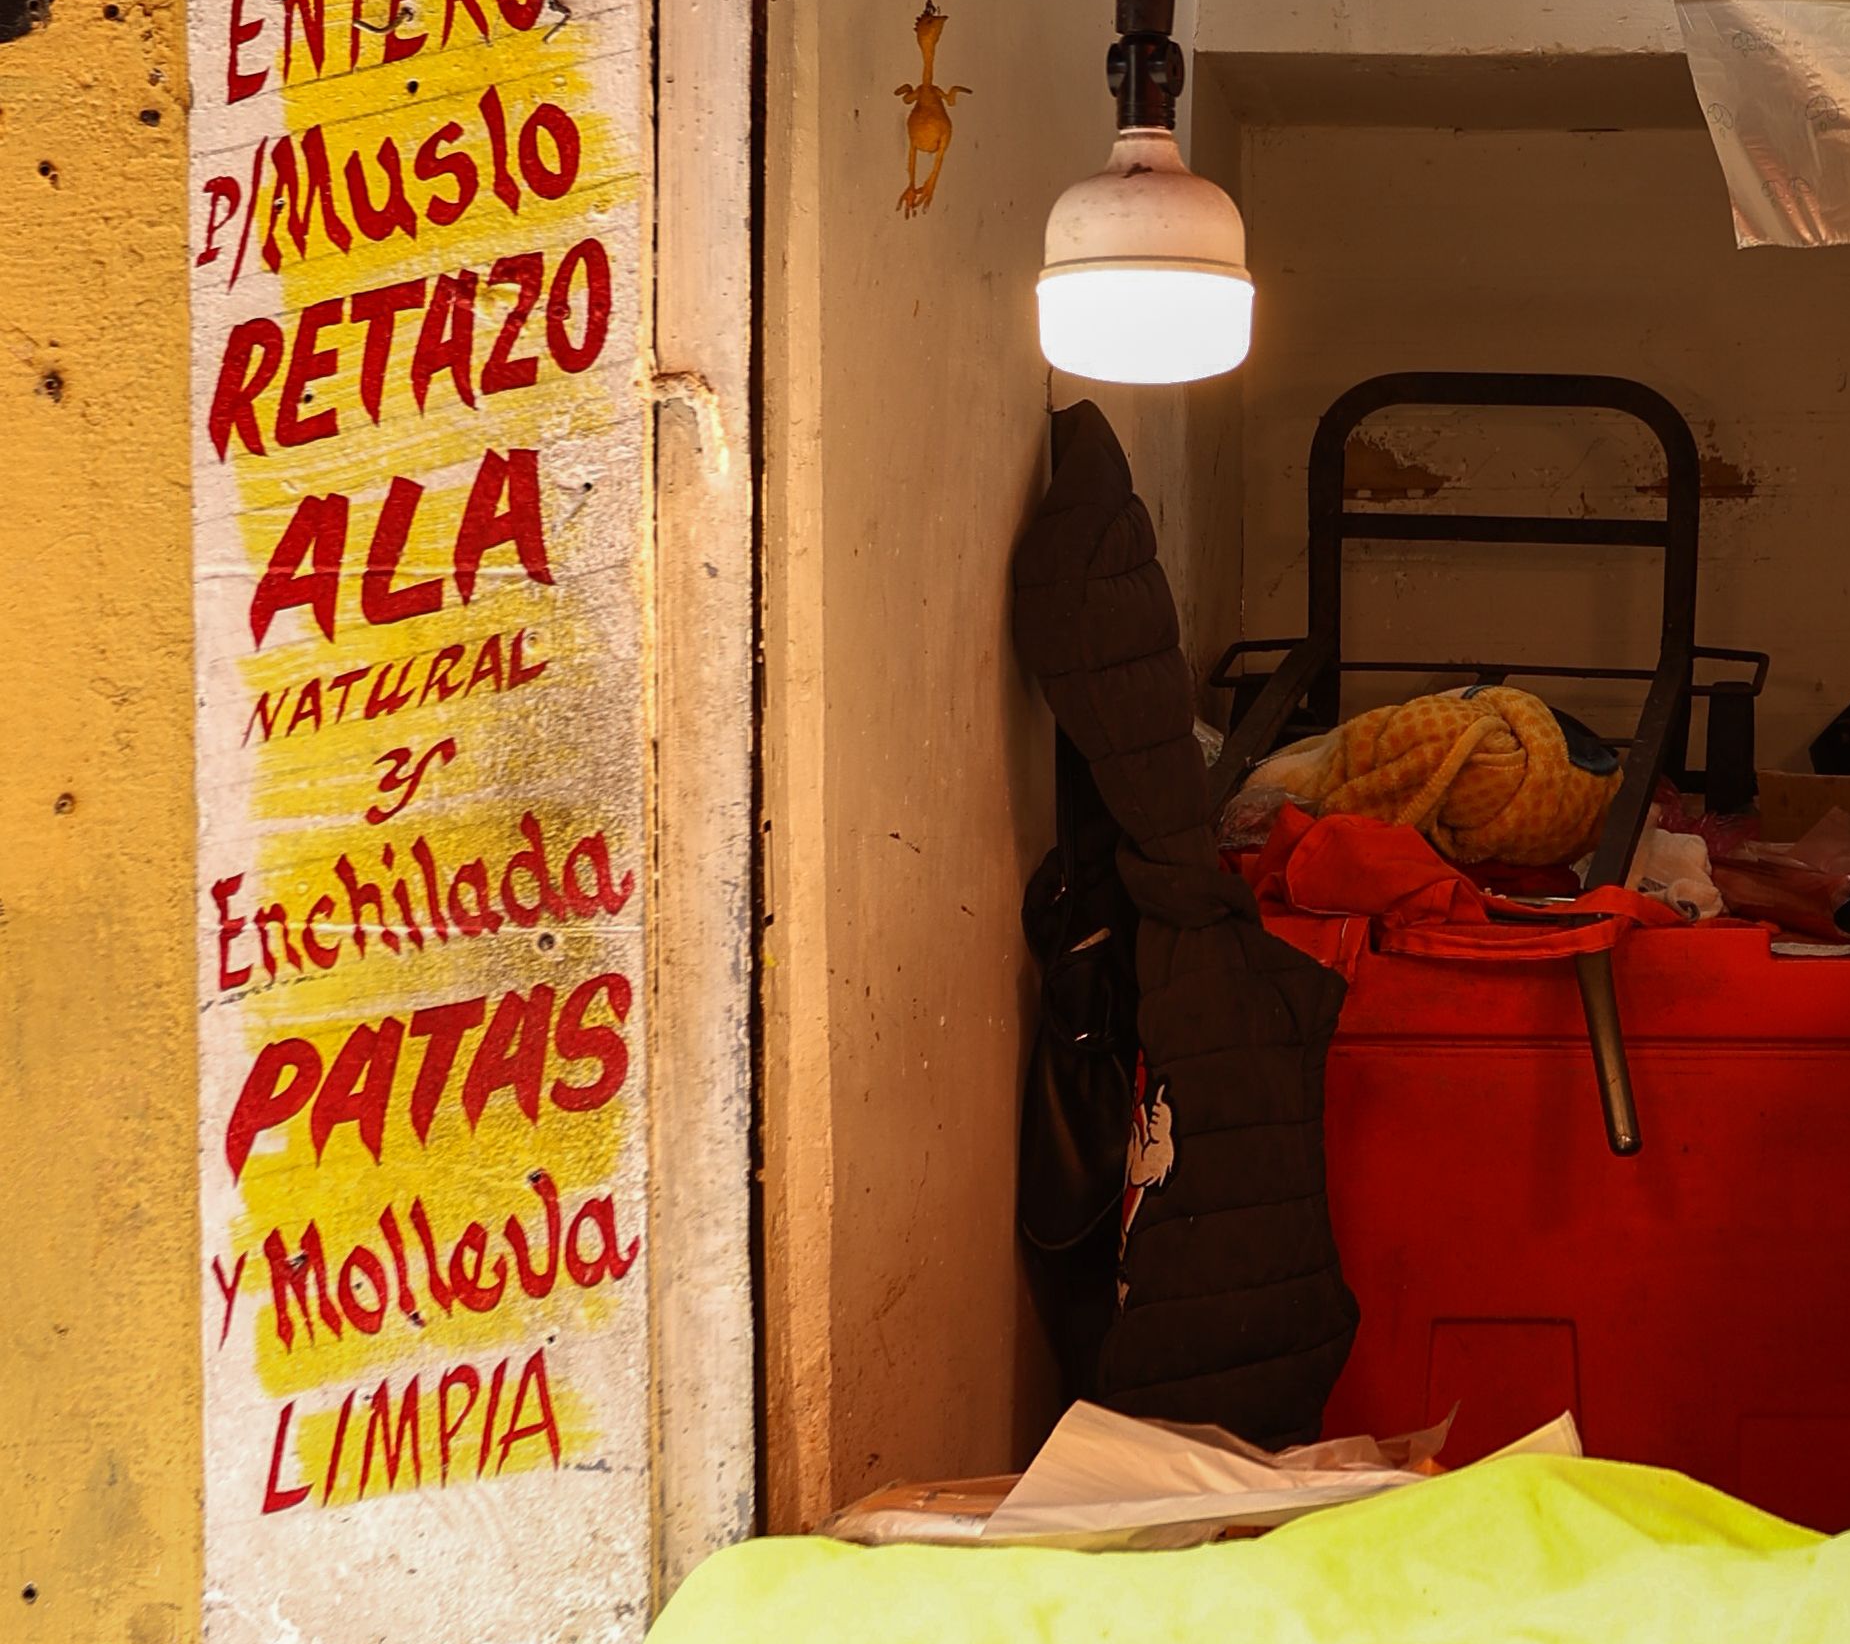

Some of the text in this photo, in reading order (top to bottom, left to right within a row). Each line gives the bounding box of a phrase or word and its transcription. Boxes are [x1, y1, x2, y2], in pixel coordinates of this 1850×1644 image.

[208, 236, 613, 463] RETAZO
[250, 447, 556, 652] ALA
[242, 628, 550, 748] NATURAL
[211, 811, 636, 991] Enchilada
[224, 972, 633, 1187] PATAS
[262, 1348, 561, 1515] LIMPIA
